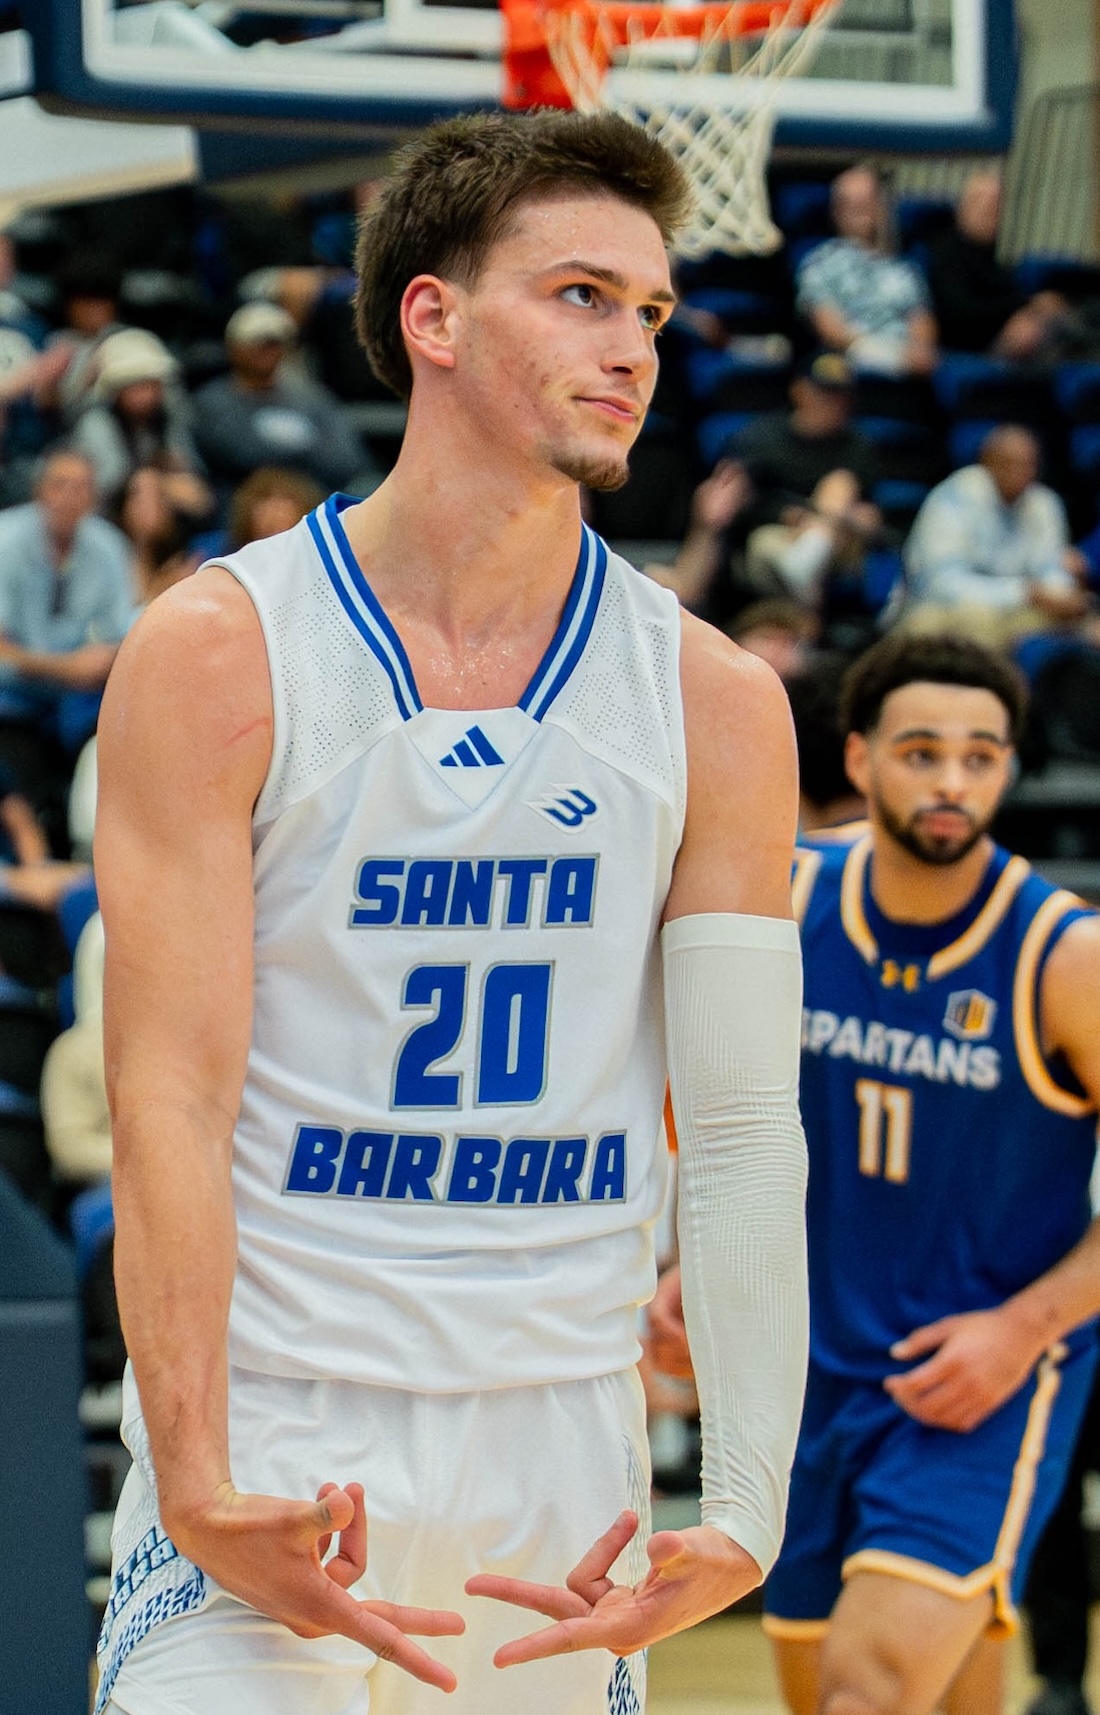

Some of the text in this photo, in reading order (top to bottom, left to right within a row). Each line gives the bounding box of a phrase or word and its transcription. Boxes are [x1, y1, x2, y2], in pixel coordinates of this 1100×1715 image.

[348, 853, 600, 930] SANTA
[389, 960, 556, 1112] 20
[281, 1122, 627, 1208] BARBARA
[856, 1078, 913, 1184] 11
